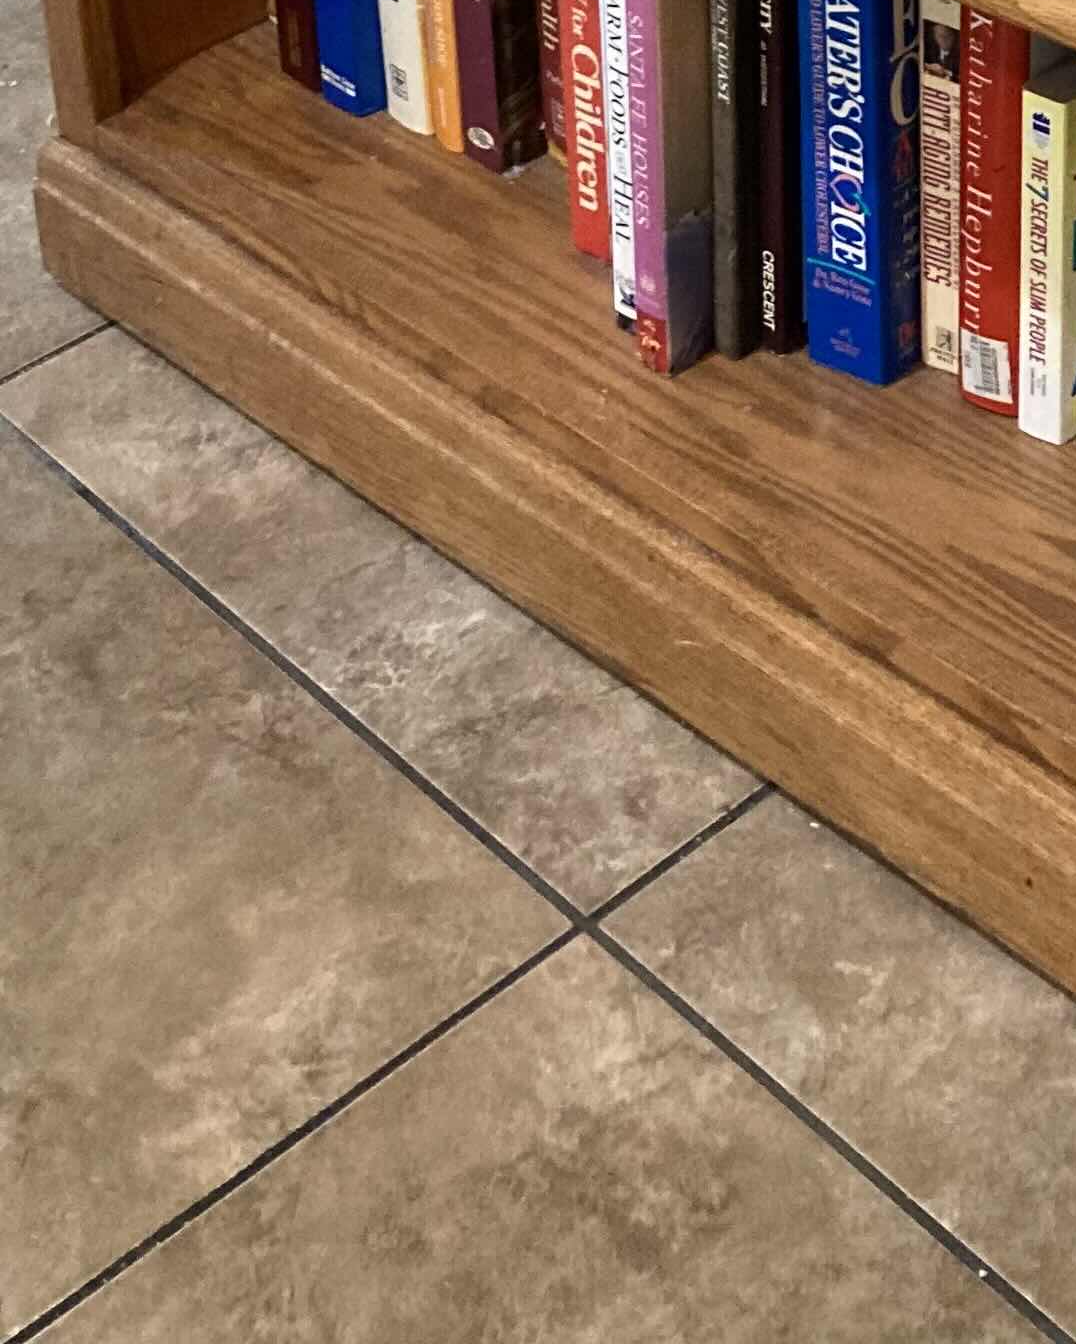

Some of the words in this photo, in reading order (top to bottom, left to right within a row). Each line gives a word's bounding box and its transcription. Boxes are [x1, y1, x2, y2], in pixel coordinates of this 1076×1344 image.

[628, 14, 646, 88] SANTA
[609, 64, 630, 148] FOODS
[632, 95, 647, 125] FE
[967, 9, 994, 177] Katharine
[922, 86, 952, 189] ANTI-AGING
[1031, 157, 1048, 183] THE
[613, 175, 634, 242] HEAL
[632, 132, 650, 229] HOUSES
[828, 123, 868, 271] CHOICE
[1024, 181, 1049, 201] 7
[923, 192, 952, 288] REMEDIES
[963, 185, 992, 334] Hepburn
[1029, 199, 1049, 256] SECRETS
[762, 250, 776, 331] CRESCENT
[1029, 279, 1047, 311] SLIM
[1030, 258, 1047, 277] OF
[1028, 313, 1047, 365] PEOPLE
